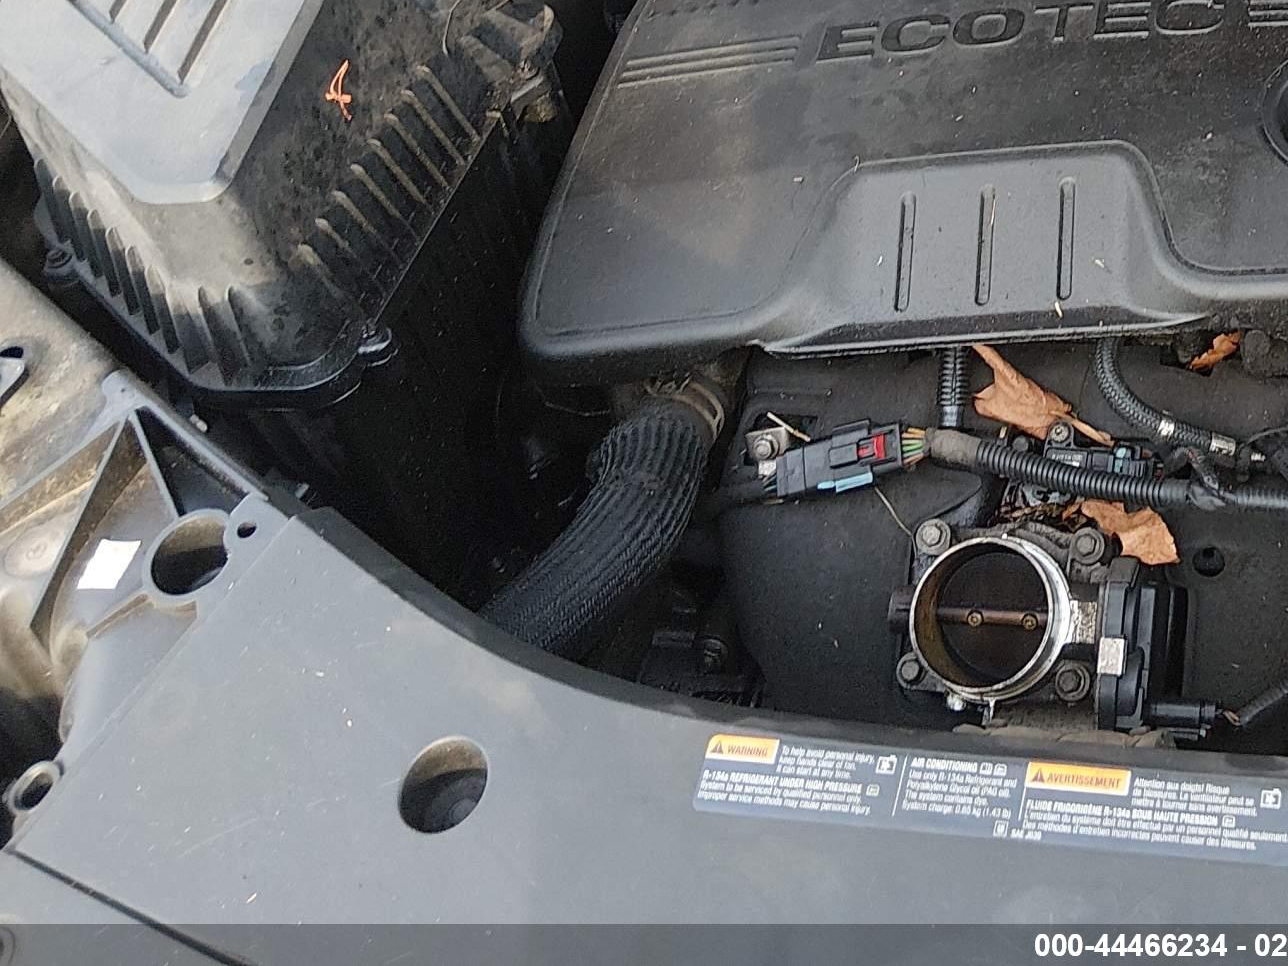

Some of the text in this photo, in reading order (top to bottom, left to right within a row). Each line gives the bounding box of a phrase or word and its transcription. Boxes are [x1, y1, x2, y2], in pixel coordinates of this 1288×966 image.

[728, 745, 768, 756] WARNING
[783, 746, 789, 754] To
[790, 746, 805, 756] help
[806, 749, 824, 757] avoid
[825, 750, 855, 761] personal
[797, 756, 816, 767] hands
[817, 759, 835, 768] clear
[836, 761, 843, 769] of
[911, 757, 978, 773] AIR CONDITIONING
[782, 765, 795, 774] can
[796, 767, 812, 775] start
[812, 768, 820, 776] at
[821, 770, 834, 779] any
[909, 769, 1017, 788] Use only R-134a Refrigerant and
[703, 770, 862, 794] R-134a REFRIGERANT UNDER HIGH PRESSURE
[949, 782, 970, 794] Glycol
[970, 785, 980, 794] oil
[1047, 773, 1121, 788] AVERTISSEMENT
[1134, 777, 1165, 788] Attention
[1166, 780, 1179, 790] aux
[1205, 783, 1230, 795] Risque
[726, 782, 734, 791] to
[734, 783, 743, 792] be
[744, 784, 772, 795] serviced
[773, 786, 782, 797] by
[905, 788, 918, 799] The
[918, 791, 943, 802] system
[943, 793, 973, 804] contains
[1132, 786, 1142, 796] de
[1179, 791, 1189, 801] Le
[1227, 796, 1244, 807] peut
[1245, 797, 1255, 806] se
[728, 794, 752, 803] service
[753, 795, 783, 806] methods
[783, 799, 799, 809] may
[799, 801, 820, 810] cause
[820, 802, 850, 813] personal
[901, 799, 927, 811] System
[1131, 797, 1155, 808] mettre
[1162, 800, 1188, 811] tourner
[1188, 803, 1206, 812] sans
[1026, 799, 1053, 811] FLUIDE
[1104, 806, 1131, 818] R-134a
[1131, 808, 1153, 821] SOUS
[1153, 811, 1179, 823] HAUTE
[1179, 813, 1218, 826] PRESSION
[1061, 813, 1071, 823] du
[1102, 816, 1116, 827] doit
[1162, 823, 1175, 833] par
[1176, 824, 1186, 833] un
[1023, 818, 1037, 829] Des
[1151, 833, 1180, 843] peuvent
[1181, 835, 1206, 845] causer
[1206, 837, 1219, 847] des
